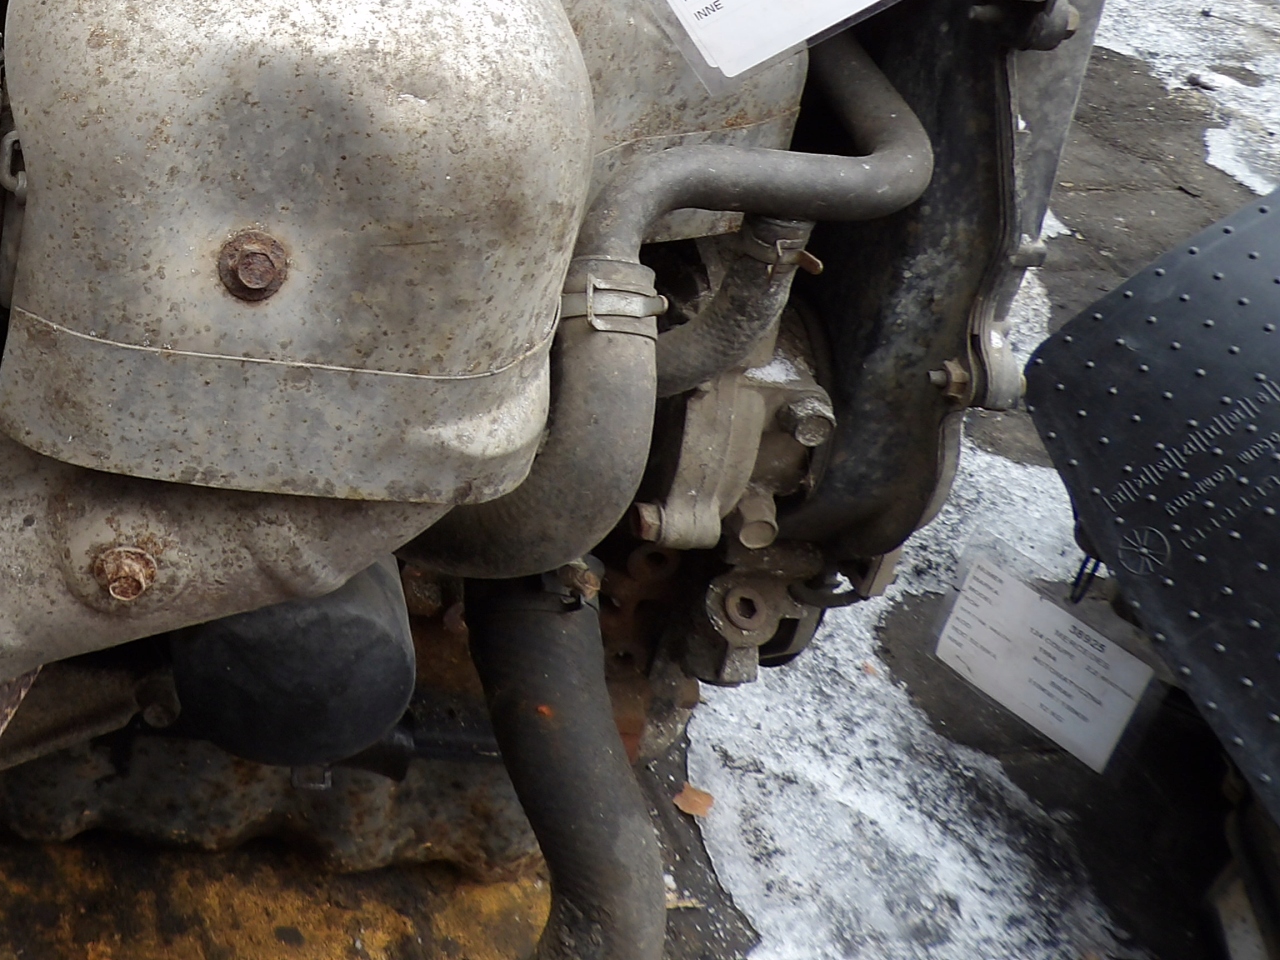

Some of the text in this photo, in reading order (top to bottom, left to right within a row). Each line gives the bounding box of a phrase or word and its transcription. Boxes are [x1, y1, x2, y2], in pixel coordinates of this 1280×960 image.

[694, 0, 724, 21] INNE
[1055, 630, 1110, 671] MERCEDES
[1069, 625, 1106, 653] 38925
